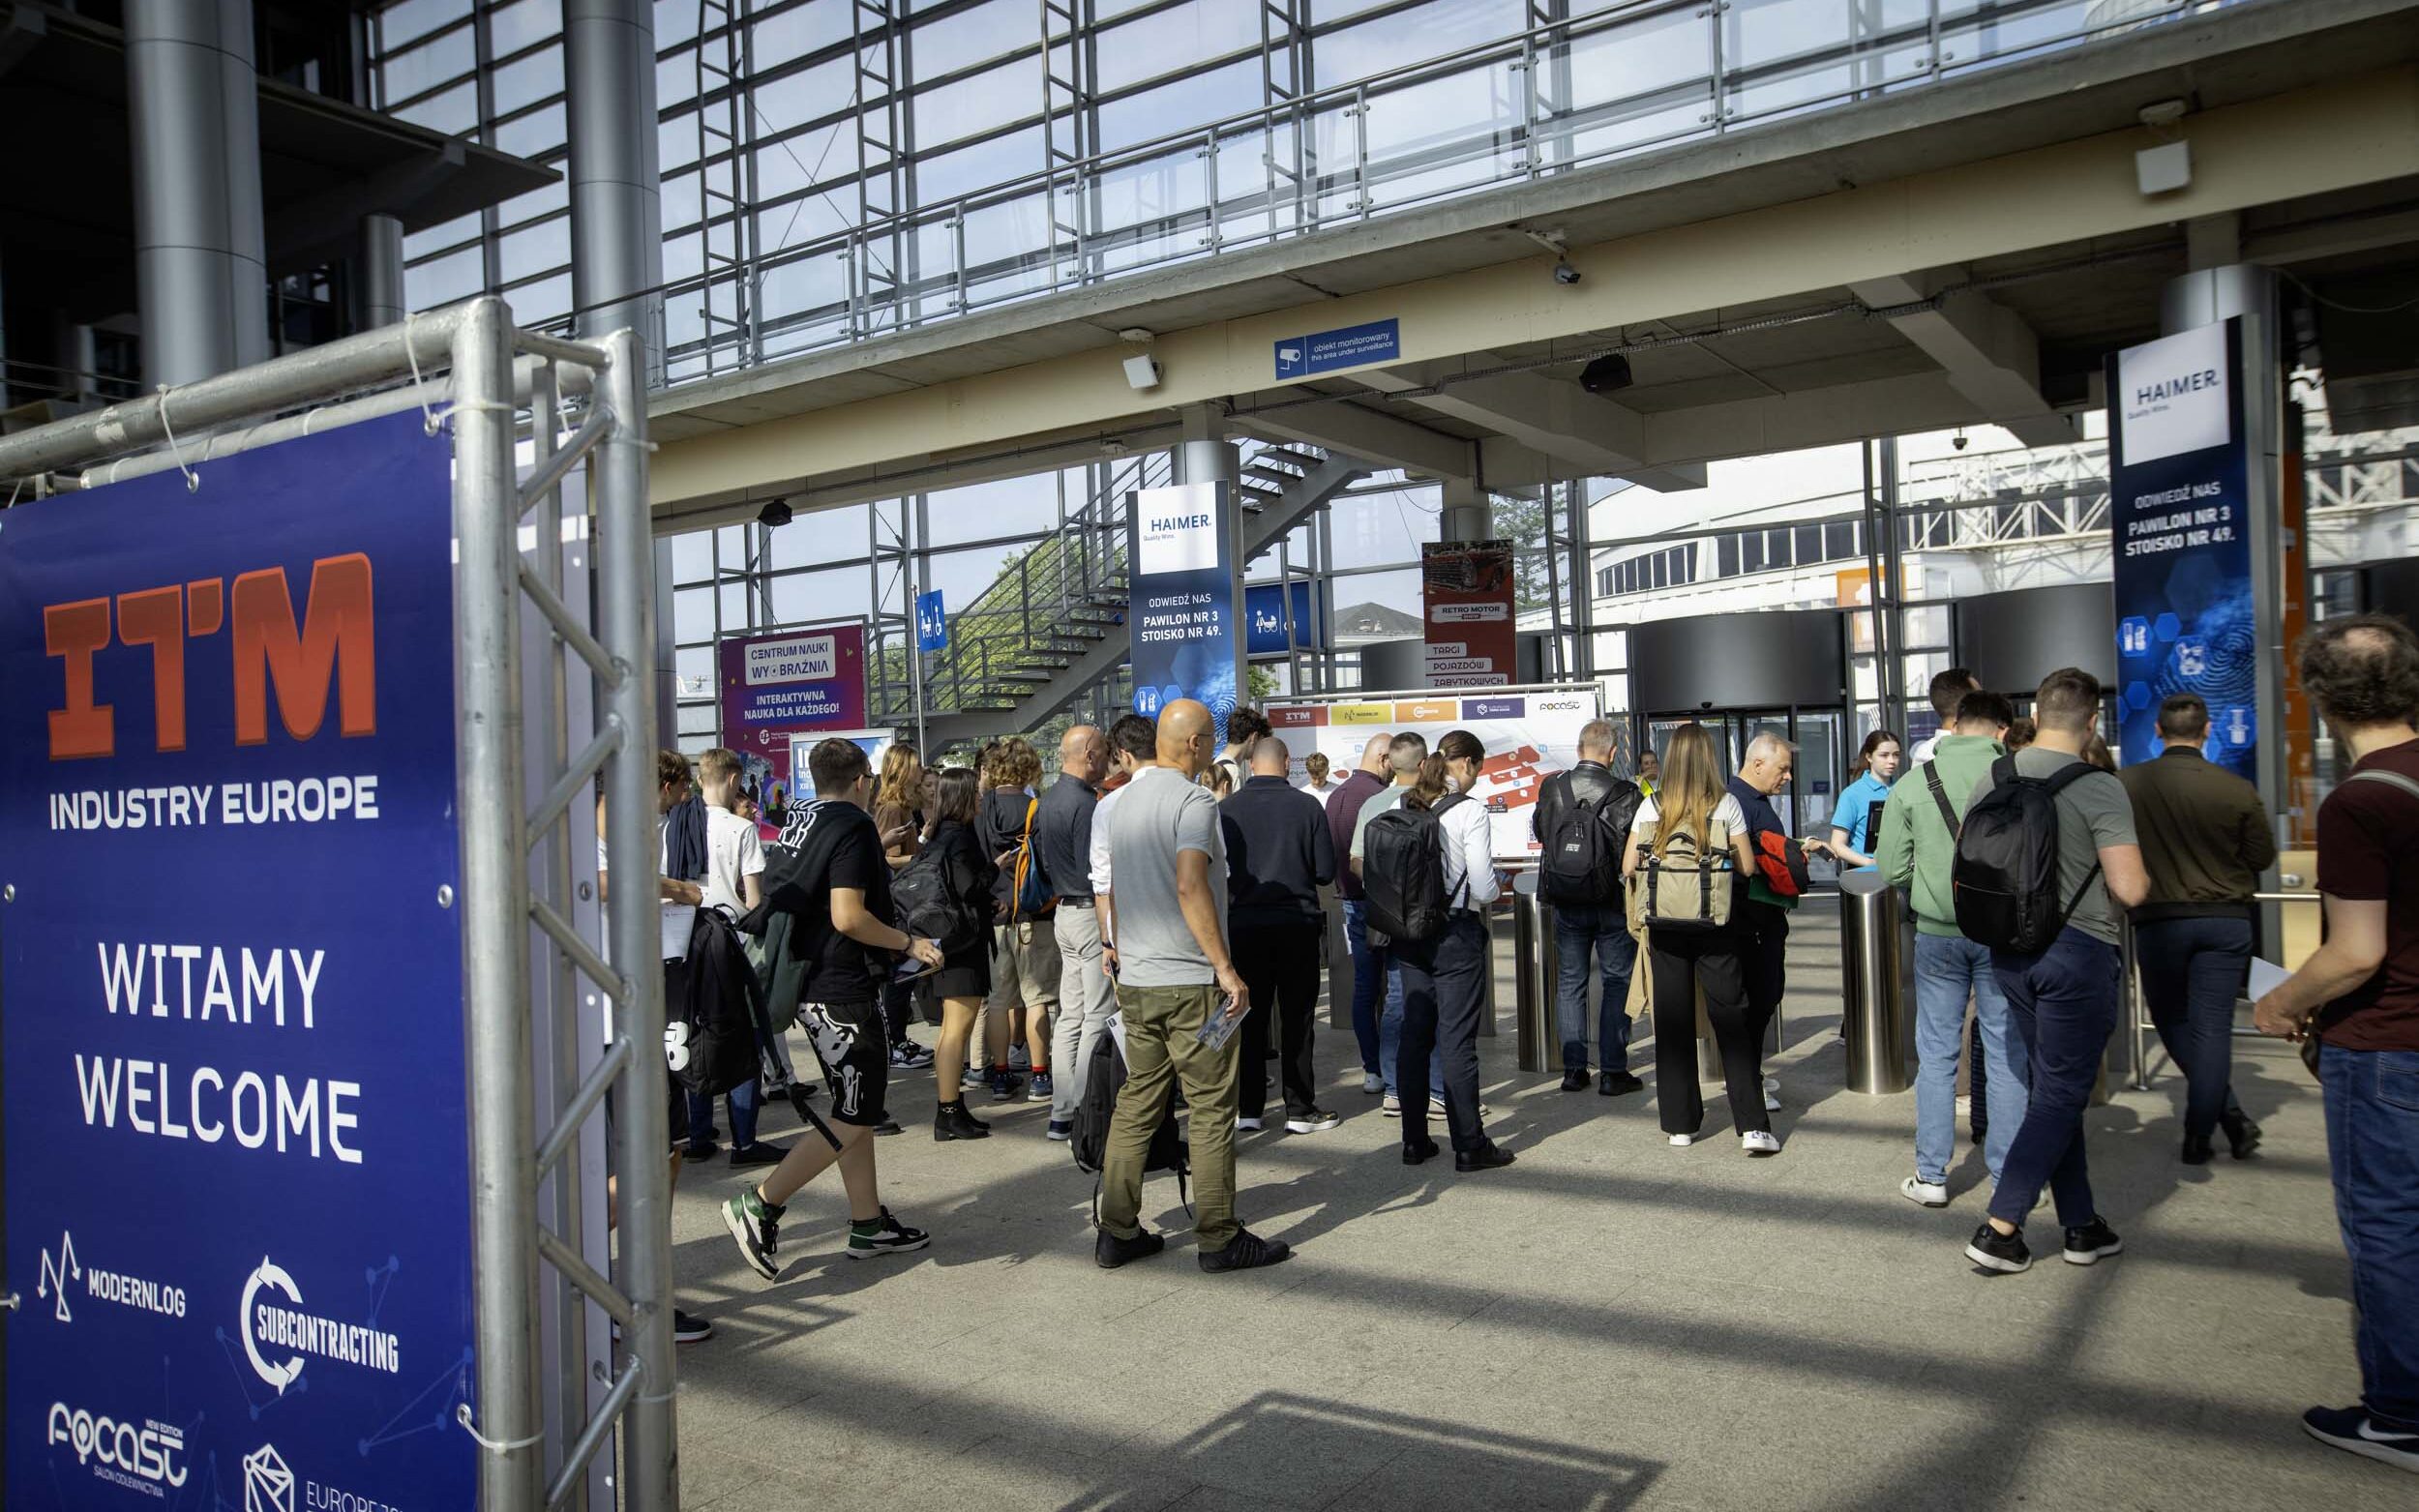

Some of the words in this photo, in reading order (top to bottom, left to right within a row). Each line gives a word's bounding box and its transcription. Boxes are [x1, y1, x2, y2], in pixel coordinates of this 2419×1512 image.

[1314, 342, 1336, 352] obiekt
[1337, 332, 1389, 347] monitorowany
[1338, 347, 1356, 356] under
[1357, 341, 1393, 353] surveillance
[2193, 482, 2222, 499] NAS
[2129, 512, 2193, 536] PAWILON
[2195, 508, 2218, 523] NR
[2220, 505, 2231, 520] 3
[2125, 534, 2184, 557] STOISKO
[2187, 529, 2211, 548] NR
[1149, 593, 1190, 608] ODWIEDŹ
[1192, 593, 1211, 605] NAS
[1143, 611, 1191, 628] PAWILON
[1193, 611, 1210, 624] NR
[1211, 610, 1218, 622] 3
[1141, 628, 1185, 642] STOISKO
[1187, 627, 1204, 638] NR
[751, 646, 797, 661] CENTRUM
[798, 641, 828, 656] NAUKI
[1433, 645, 1460, 655] TARGI
[1433, 659, 1484, 670] POJAZDÓW
[1434, 677, 1504, 688] ZABYTKOWYCH
[757, 690, 825, 706] INTERAKTYWNA
[744, 709, 775, 721] NAUKA
[776, 706, 793, 718] DLA
[795, 701, 840, 716] KAŻDEGO!
[1285, 711, 1311, 720] ITM
[49, 785, 213, 830] INDUSTRY
[222, 775, 379, 824] EUROPE
[98, 942, 325, 1028] WITAMY
[75, 1053, 363, 1164] WELCOME
[87, 1268, 187, 1319] MODERNLOG
[256, 1304, 400, 1374] SUBCONTRACTING
[146, 1418, 159, 1432] NEW
[160, 1422, 184, 1439] EDITION
[94, 1464, 116, 1483] SALON
[116, 1471, 164, 1498] ODLEWNICTWA
